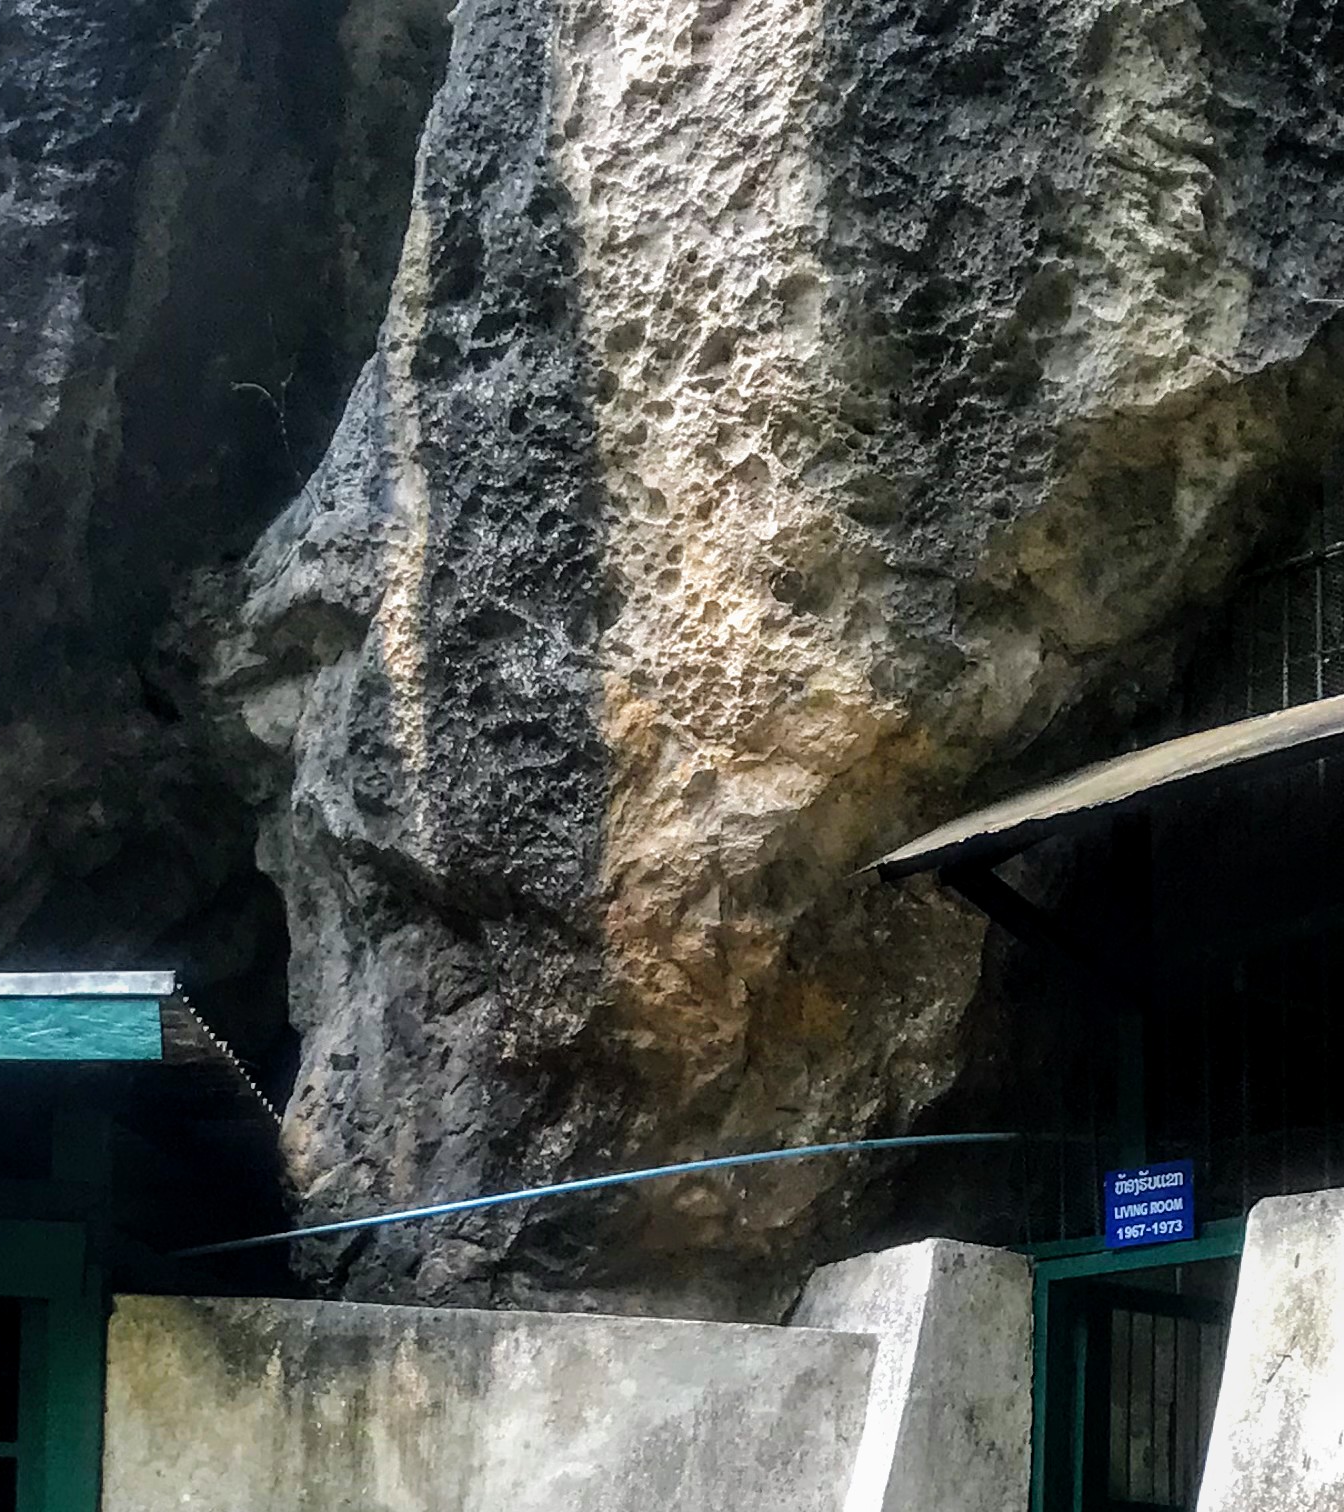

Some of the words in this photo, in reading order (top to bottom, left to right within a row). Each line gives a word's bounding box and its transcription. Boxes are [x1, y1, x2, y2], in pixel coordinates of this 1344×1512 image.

[1114, 1203, 1148, 1220] LIVING
[1149, 1197, 1184, 1214] ROOM
[1116, 1219, 1184, 1241] 1967-1973
